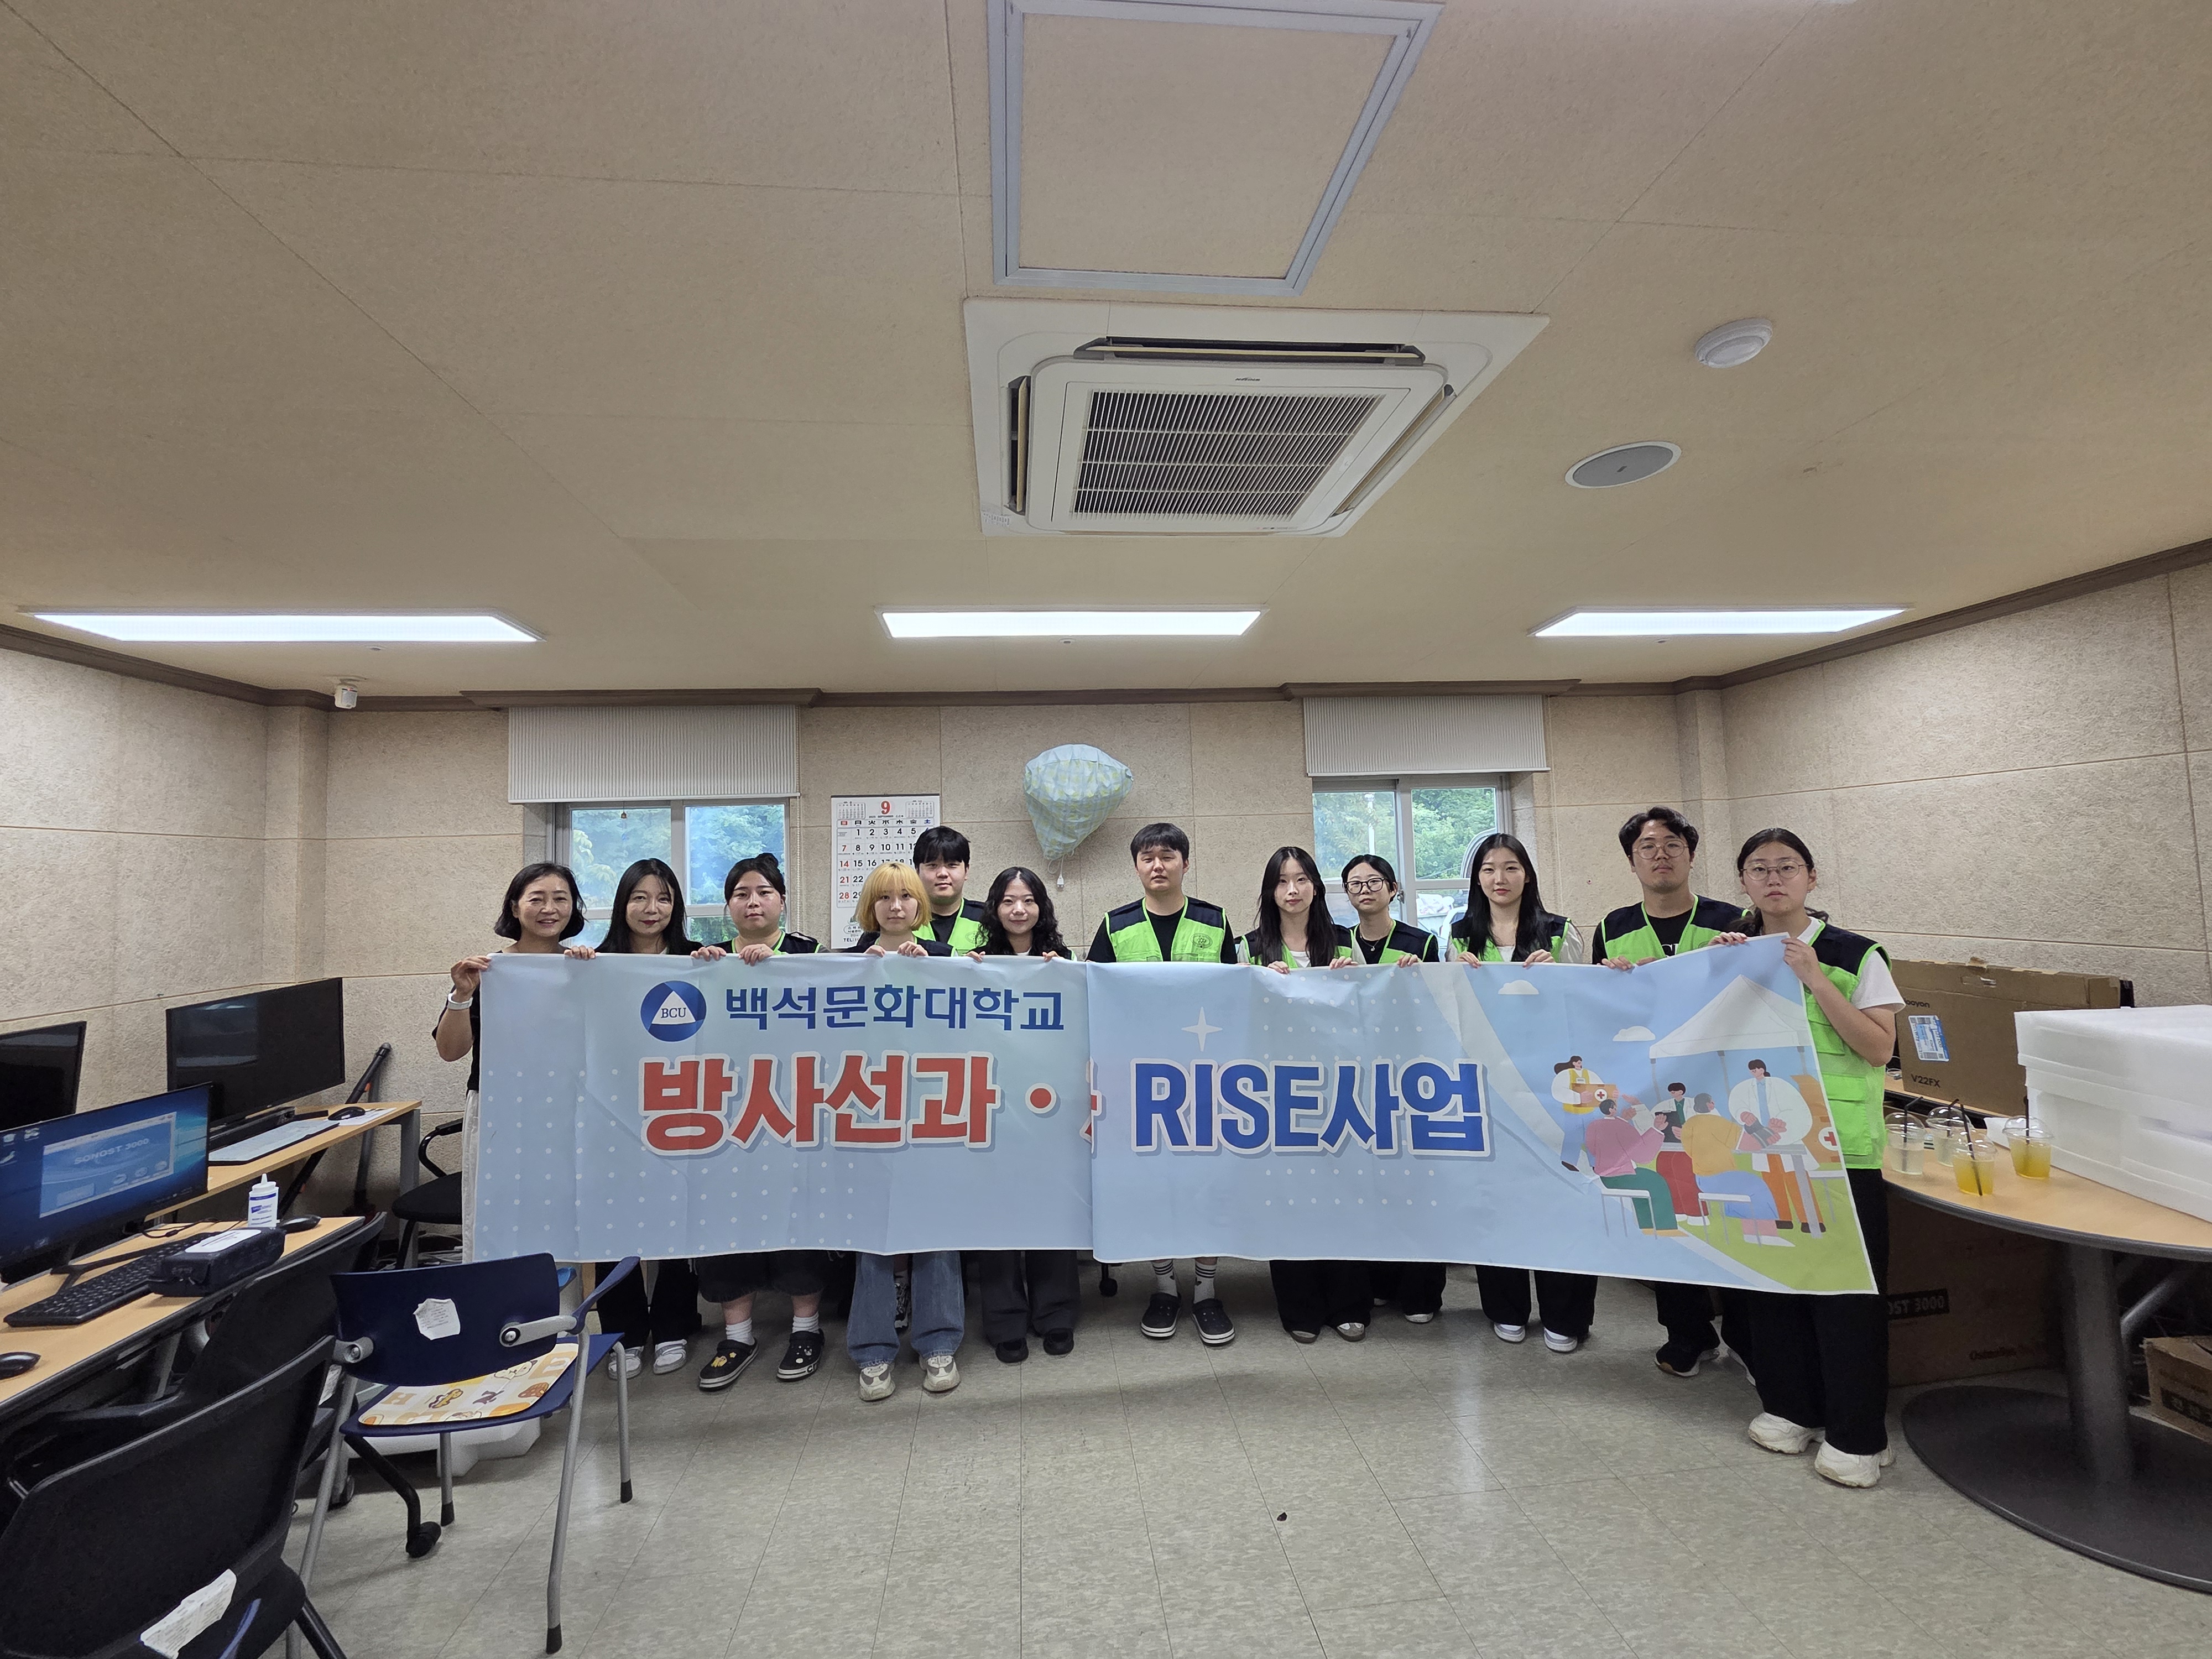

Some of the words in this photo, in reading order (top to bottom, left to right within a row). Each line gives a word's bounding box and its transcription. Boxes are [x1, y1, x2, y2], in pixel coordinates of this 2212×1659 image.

[881, 801, 890, 815] 9
[661, 1008, 686, 1018] BCU
[725, 984, 1064, 1031] 백석문화대학교
[1911, 1073, 1940, 1088] V22FX
[642, 1054, 998, 1151] 방사선과
[1134, 1061, 1486, 1152] RISE사업
[74, 1145, 122, 1165] SONOST
[125, 1138, 149, 1150] 3000
[1913, 1296, 1945, 1312] 3000
